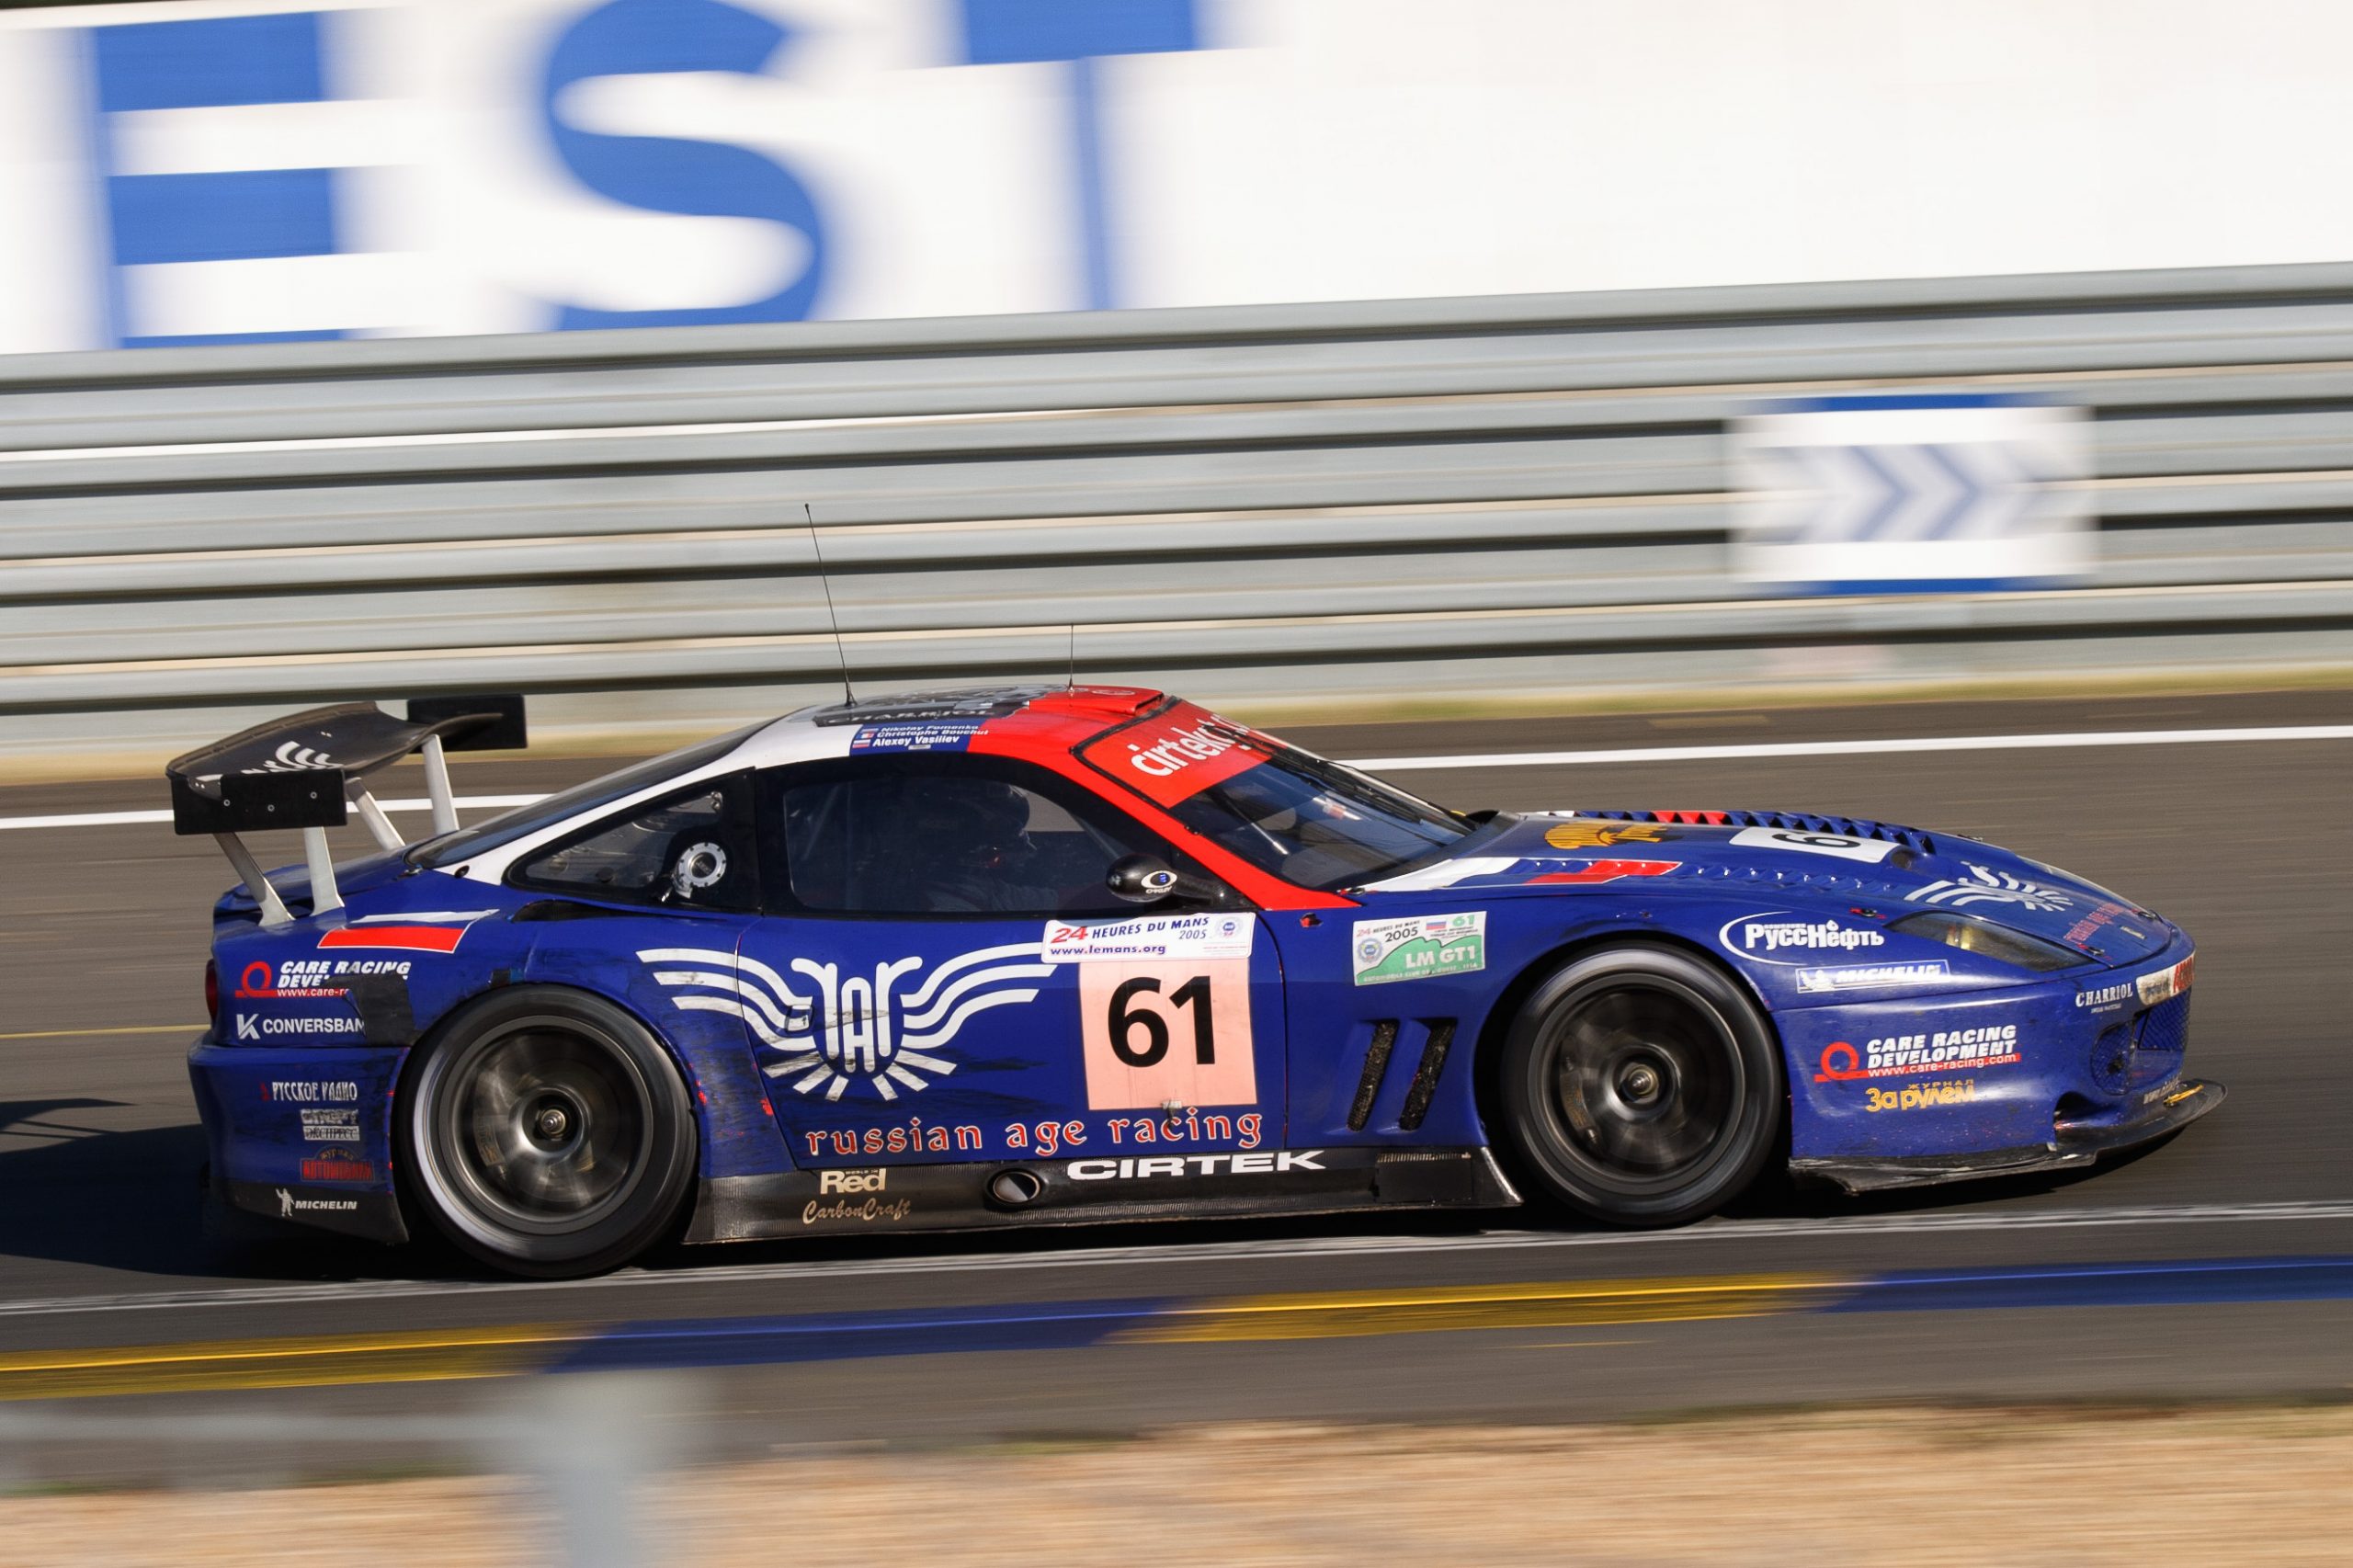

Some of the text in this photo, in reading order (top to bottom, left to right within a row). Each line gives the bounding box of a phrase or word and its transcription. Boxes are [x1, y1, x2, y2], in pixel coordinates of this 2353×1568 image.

[872, 737, 912, 747] Alexey
[915, 735, 961, 744] Vasiliev
[1051, 917, 1210, 944] 24 HEURES DU MANS
[1451, 915, 1476, 927] 61
[1178, 929, 1207, 939] 2005
[1385, 926, 1418, 943] 2005
[1745, 920, 1885, 950] РуссНефть
[1051, 945, 1165, 955] www.lemans.org
[1405, 945, 1475, 968] LM GT1
[279, 960, 412, 974] CARE RACING
[2075, 983, 2133, 1007] CHARRIOL
[1108, 975, 1216, 1068] 61
[1866, 1025, 2017, 1054] CARE RACING
[1868, 1040, 2017, 1069] DEVELOPMENT
[1868, 1053, 2017, 1077] www.care-racing.com
[1865, 1087, 1898, 1112] За
[805, 1106, 1263, 1156] russian age racing
[1067, 1150, 1326, 1180] CIRTEK
[820, 1168, 887, 1195] Red
[295, 1200, 358, 1210] MICHELIN
